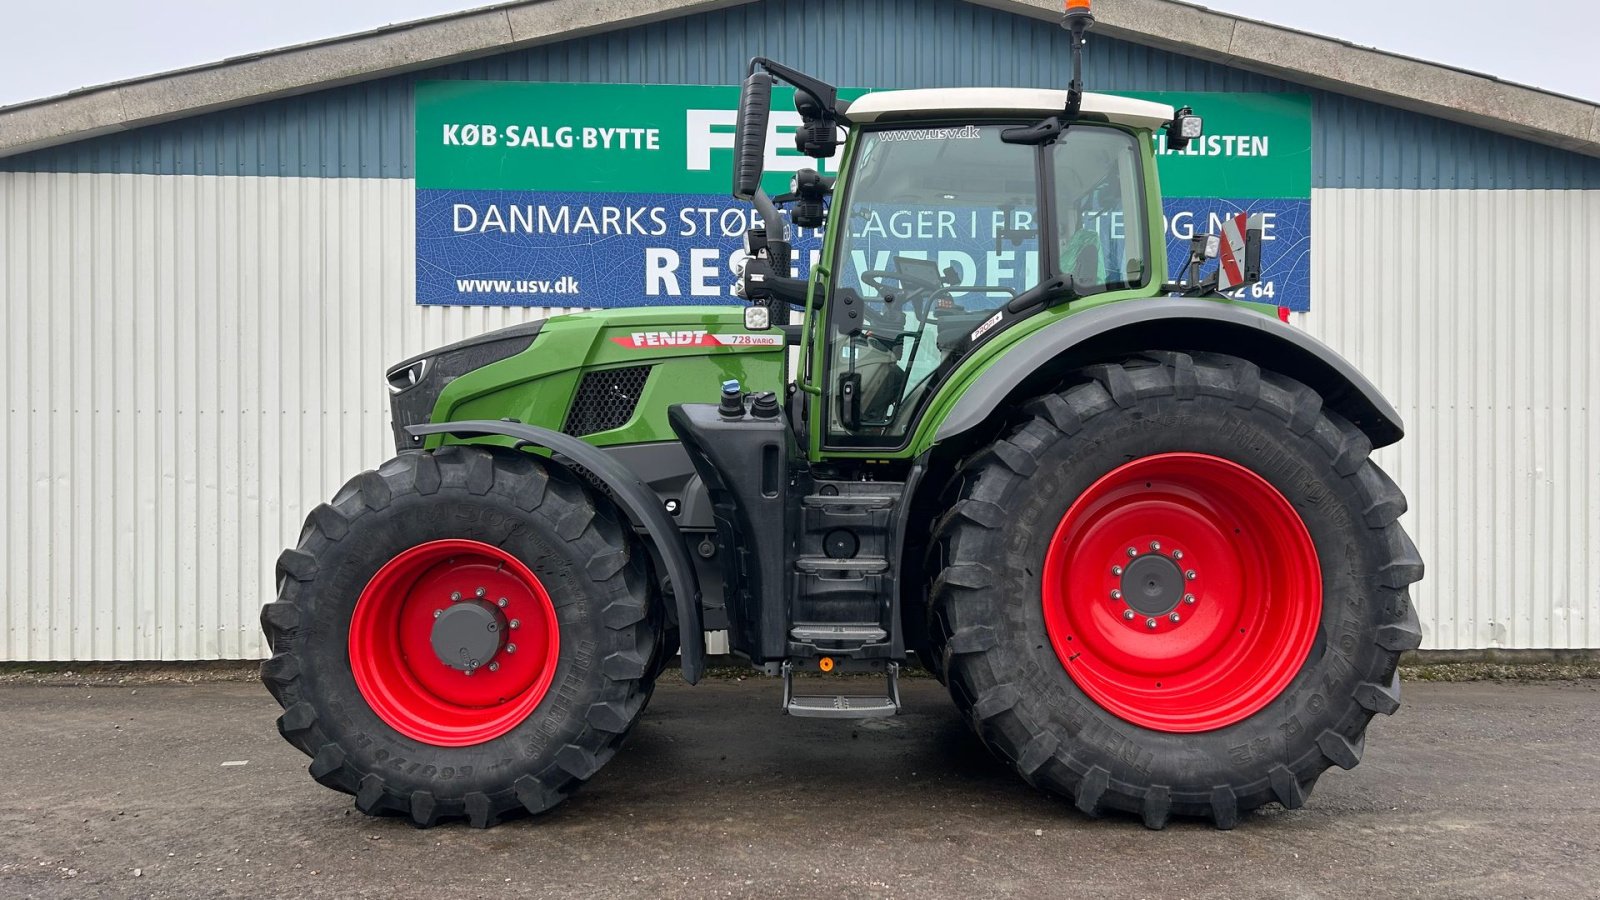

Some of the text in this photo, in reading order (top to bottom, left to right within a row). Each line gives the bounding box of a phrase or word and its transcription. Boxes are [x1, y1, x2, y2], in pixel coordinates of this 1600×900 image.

[879, 125, 981, 141] www.usv.dk
[453, 203, 667, 236] DANMARKS
[846, 209, 957, 239] AGER
[1209, 211, 1276, 240] NE
[456, 276, 579, 295] www.usv.dk
[1251, 281, 1275, 299] 64
[631, 330, 708, 347] FENDT
[731, 335, 751, 344] 728
